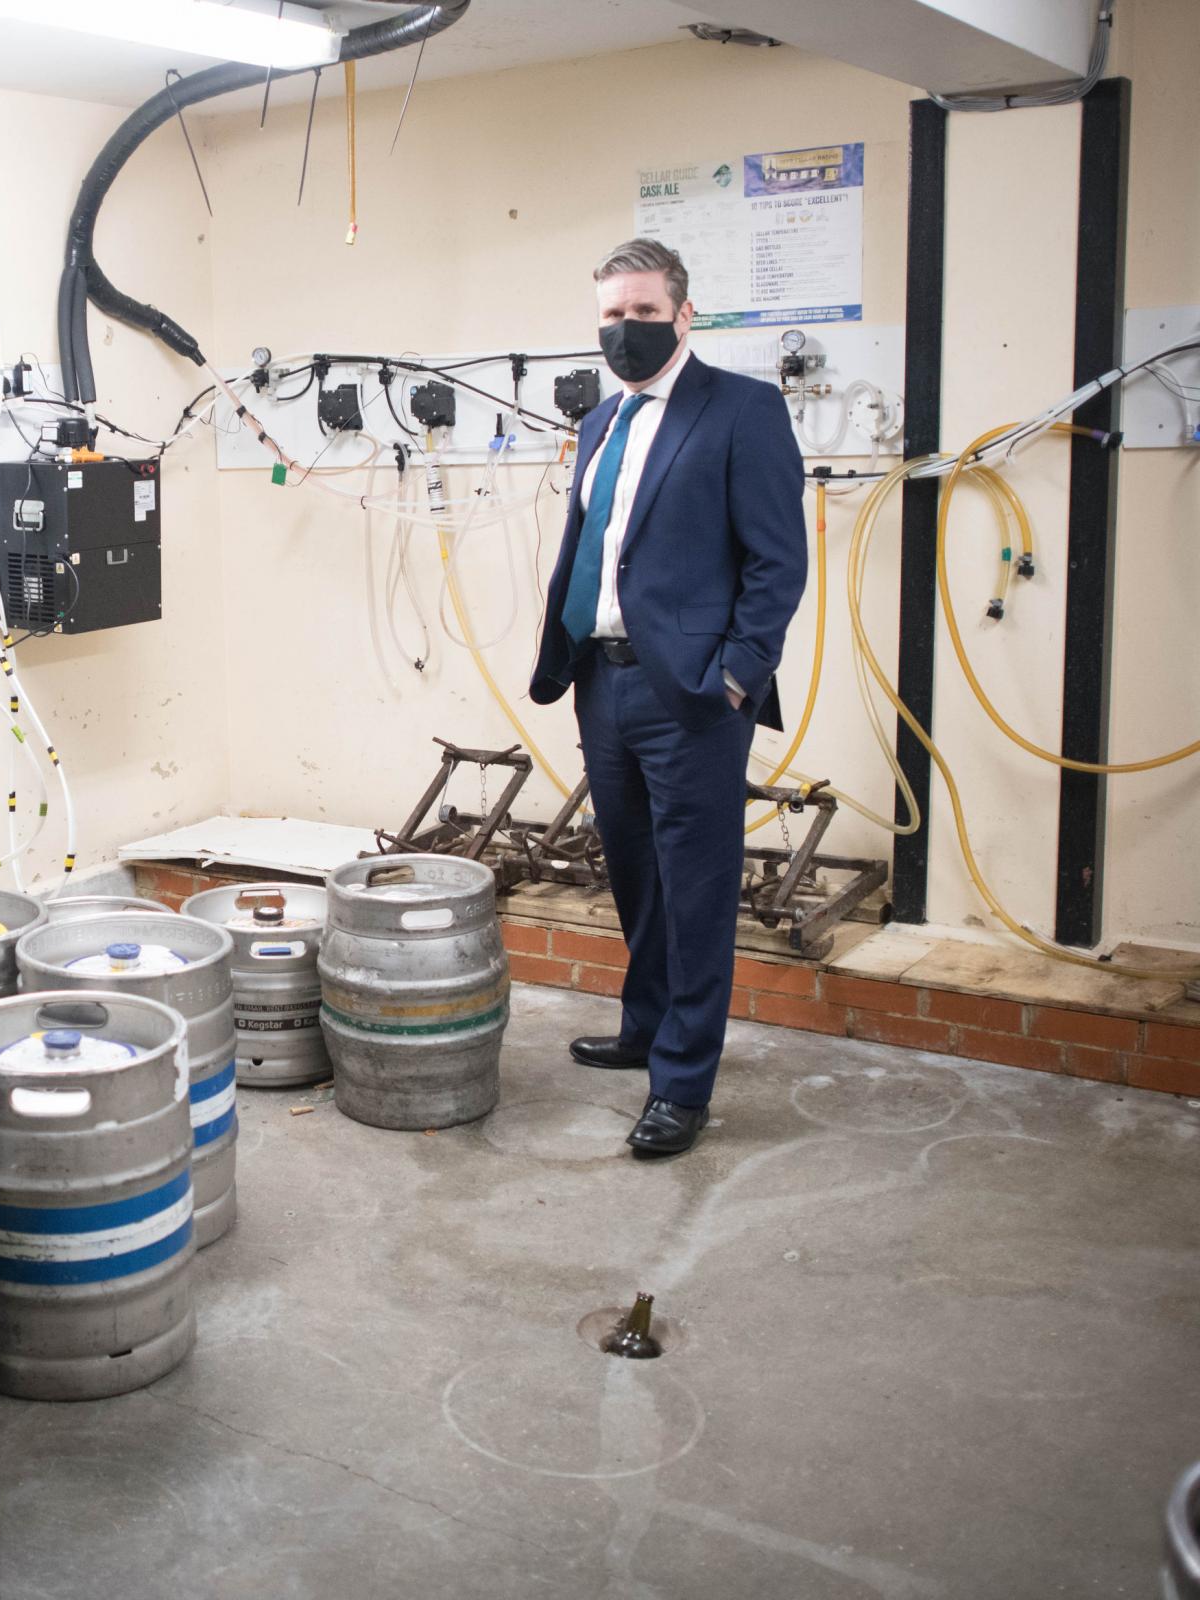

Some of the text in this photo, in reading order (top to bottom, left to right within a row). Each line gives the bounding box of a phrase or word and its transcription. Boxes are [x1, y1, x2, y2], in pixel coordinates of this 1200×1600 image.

[640, 166, 700, 185] CELLAR GUIDE
[640, 182, 680, 199] CASK ALE
[248, 1020, 284, 1031] Kegstar
